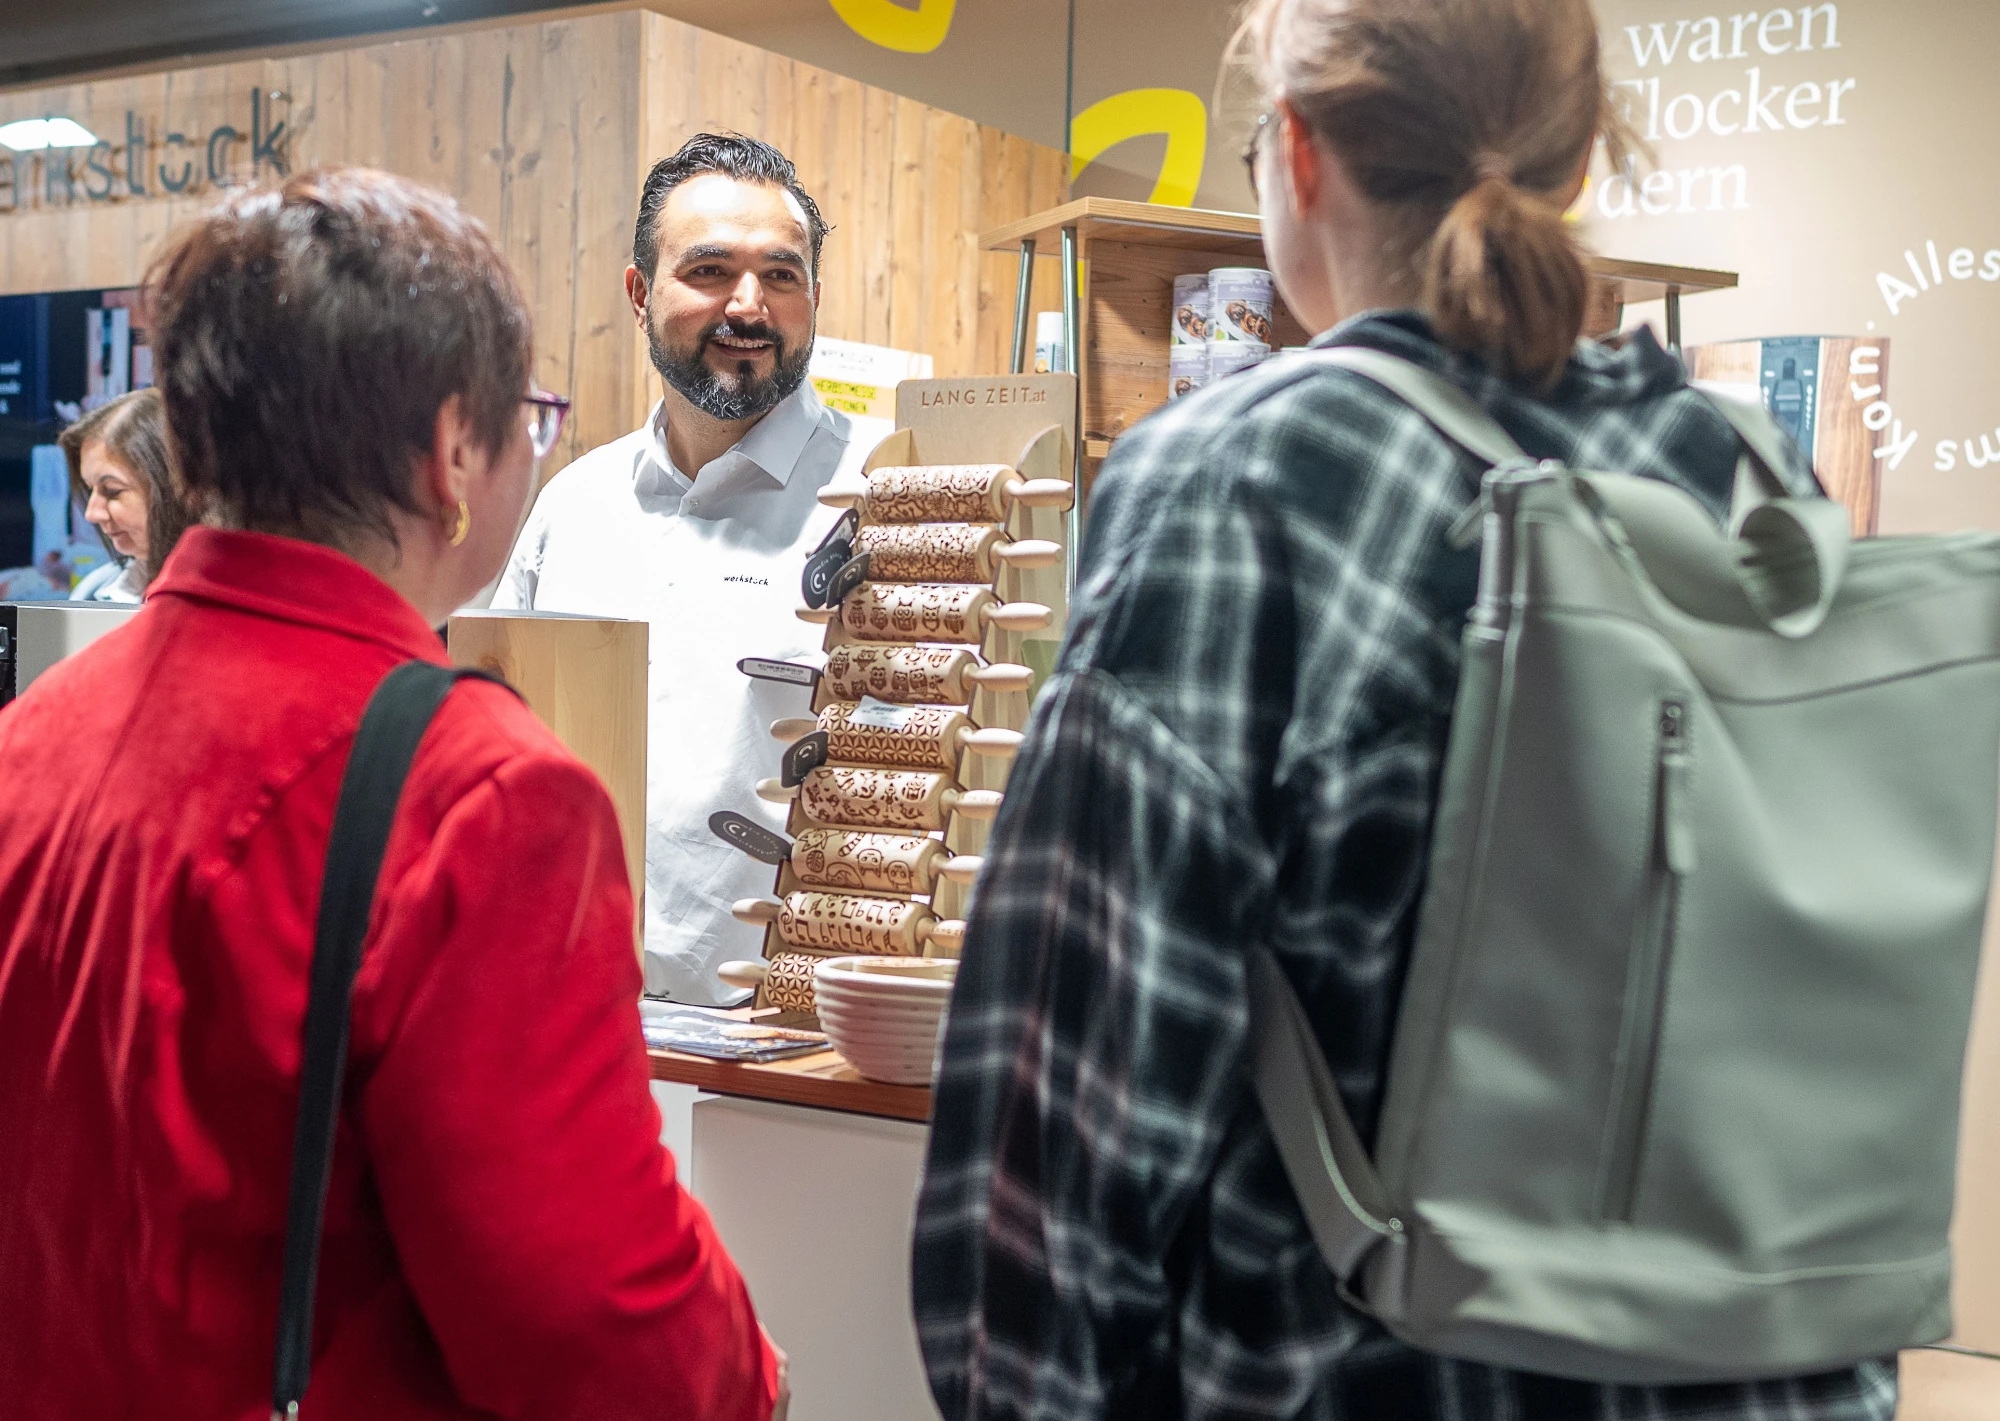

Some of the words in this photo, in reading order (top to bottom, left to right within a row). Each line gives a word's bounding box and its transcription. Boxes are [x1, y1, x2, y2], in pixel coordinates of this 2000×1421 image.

[1624, 2, 1842, 68] waren
[1876, 239, 2000, 316] Alles
[921, 389, 976, 406] LANG
[985, 386, 1047, 405] ZEIT.at
